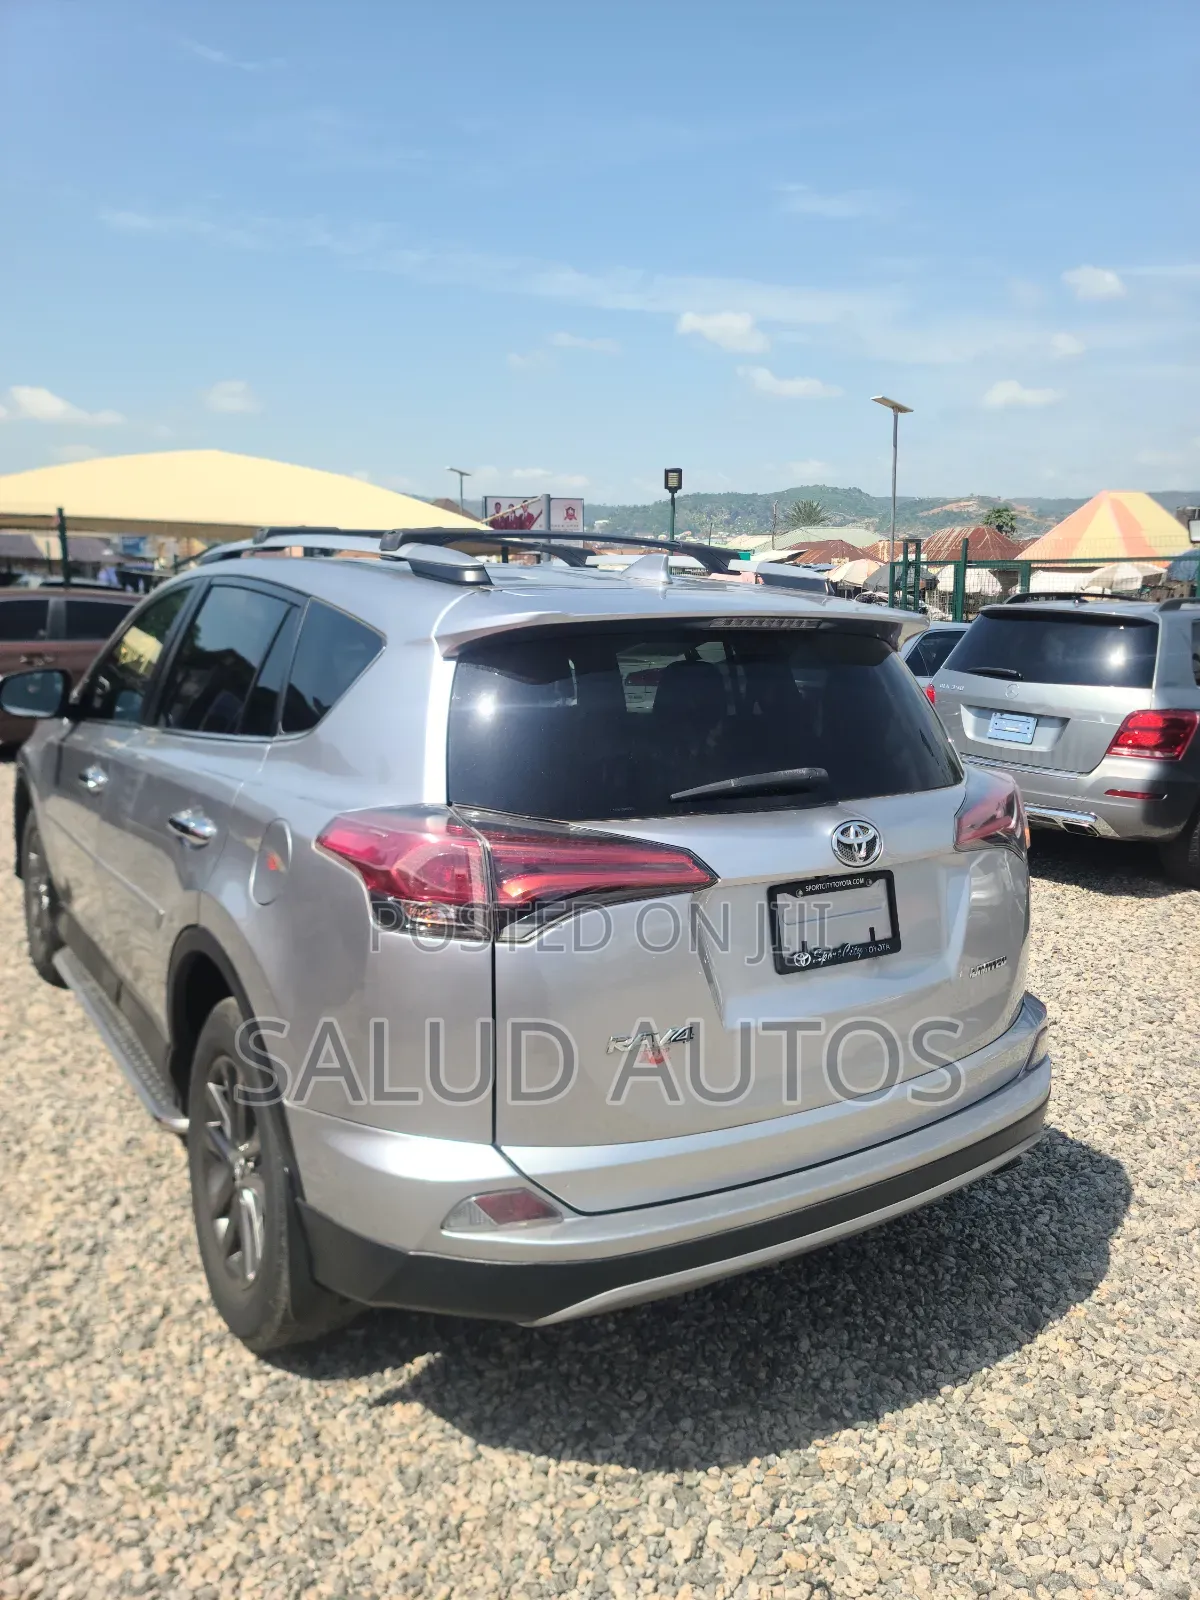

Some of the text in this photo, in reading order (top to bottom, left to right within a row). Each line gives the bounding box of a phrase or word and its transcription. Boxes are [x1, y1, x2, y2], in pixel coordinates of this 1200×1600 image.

[805, 877, 865, 892] SPORTCITYTOYOTA.COM
[842, 943, 864, 960] City
[865, 943, 891, 954] OYOTA
[606, 1025, 695, 1055] RAV4
